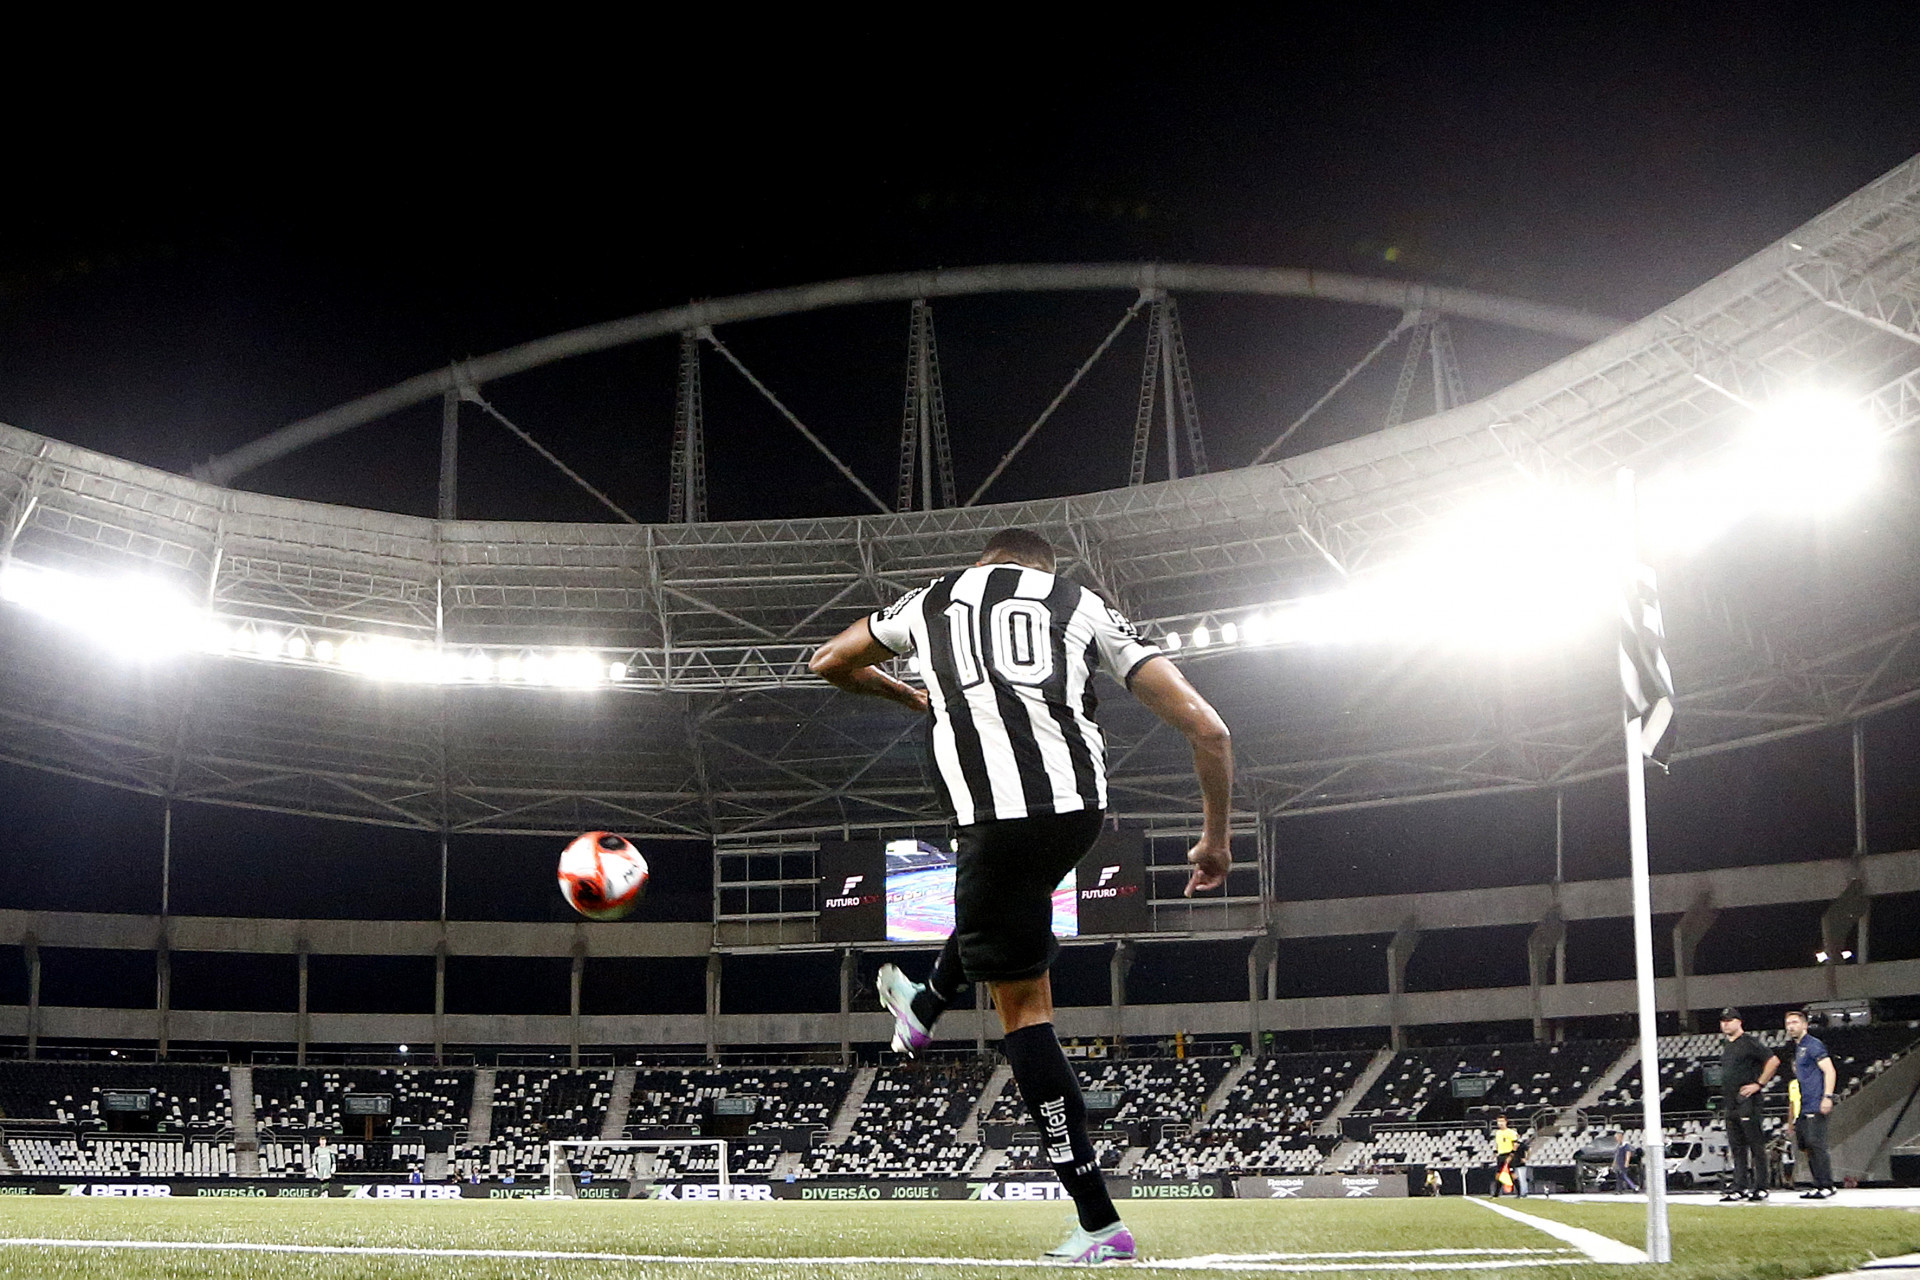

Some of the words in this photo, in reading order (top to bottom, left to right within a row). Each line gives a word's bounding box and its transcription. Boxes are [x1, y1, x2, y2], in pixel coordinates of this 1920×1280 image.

[943, 598, 1053, 688] 10
[1081, 888, 1117, 900] FUTURO
[825, 897, 860, 908] FUTURO
[1267, 1179, 1304, 1187] Reebok
[1342, 1178, 1379, 1186] Reebok
[197, 1186, 267, 1197] DIVERSÃO
[276, 1188, 310, 1198] JOGUE
[802, 1185, 880, 1200] DIVERSÃO
[891, 1187, 929, 1199] JOGUE
[1131, 1182, 1214, 1198] DIVERSÃO
